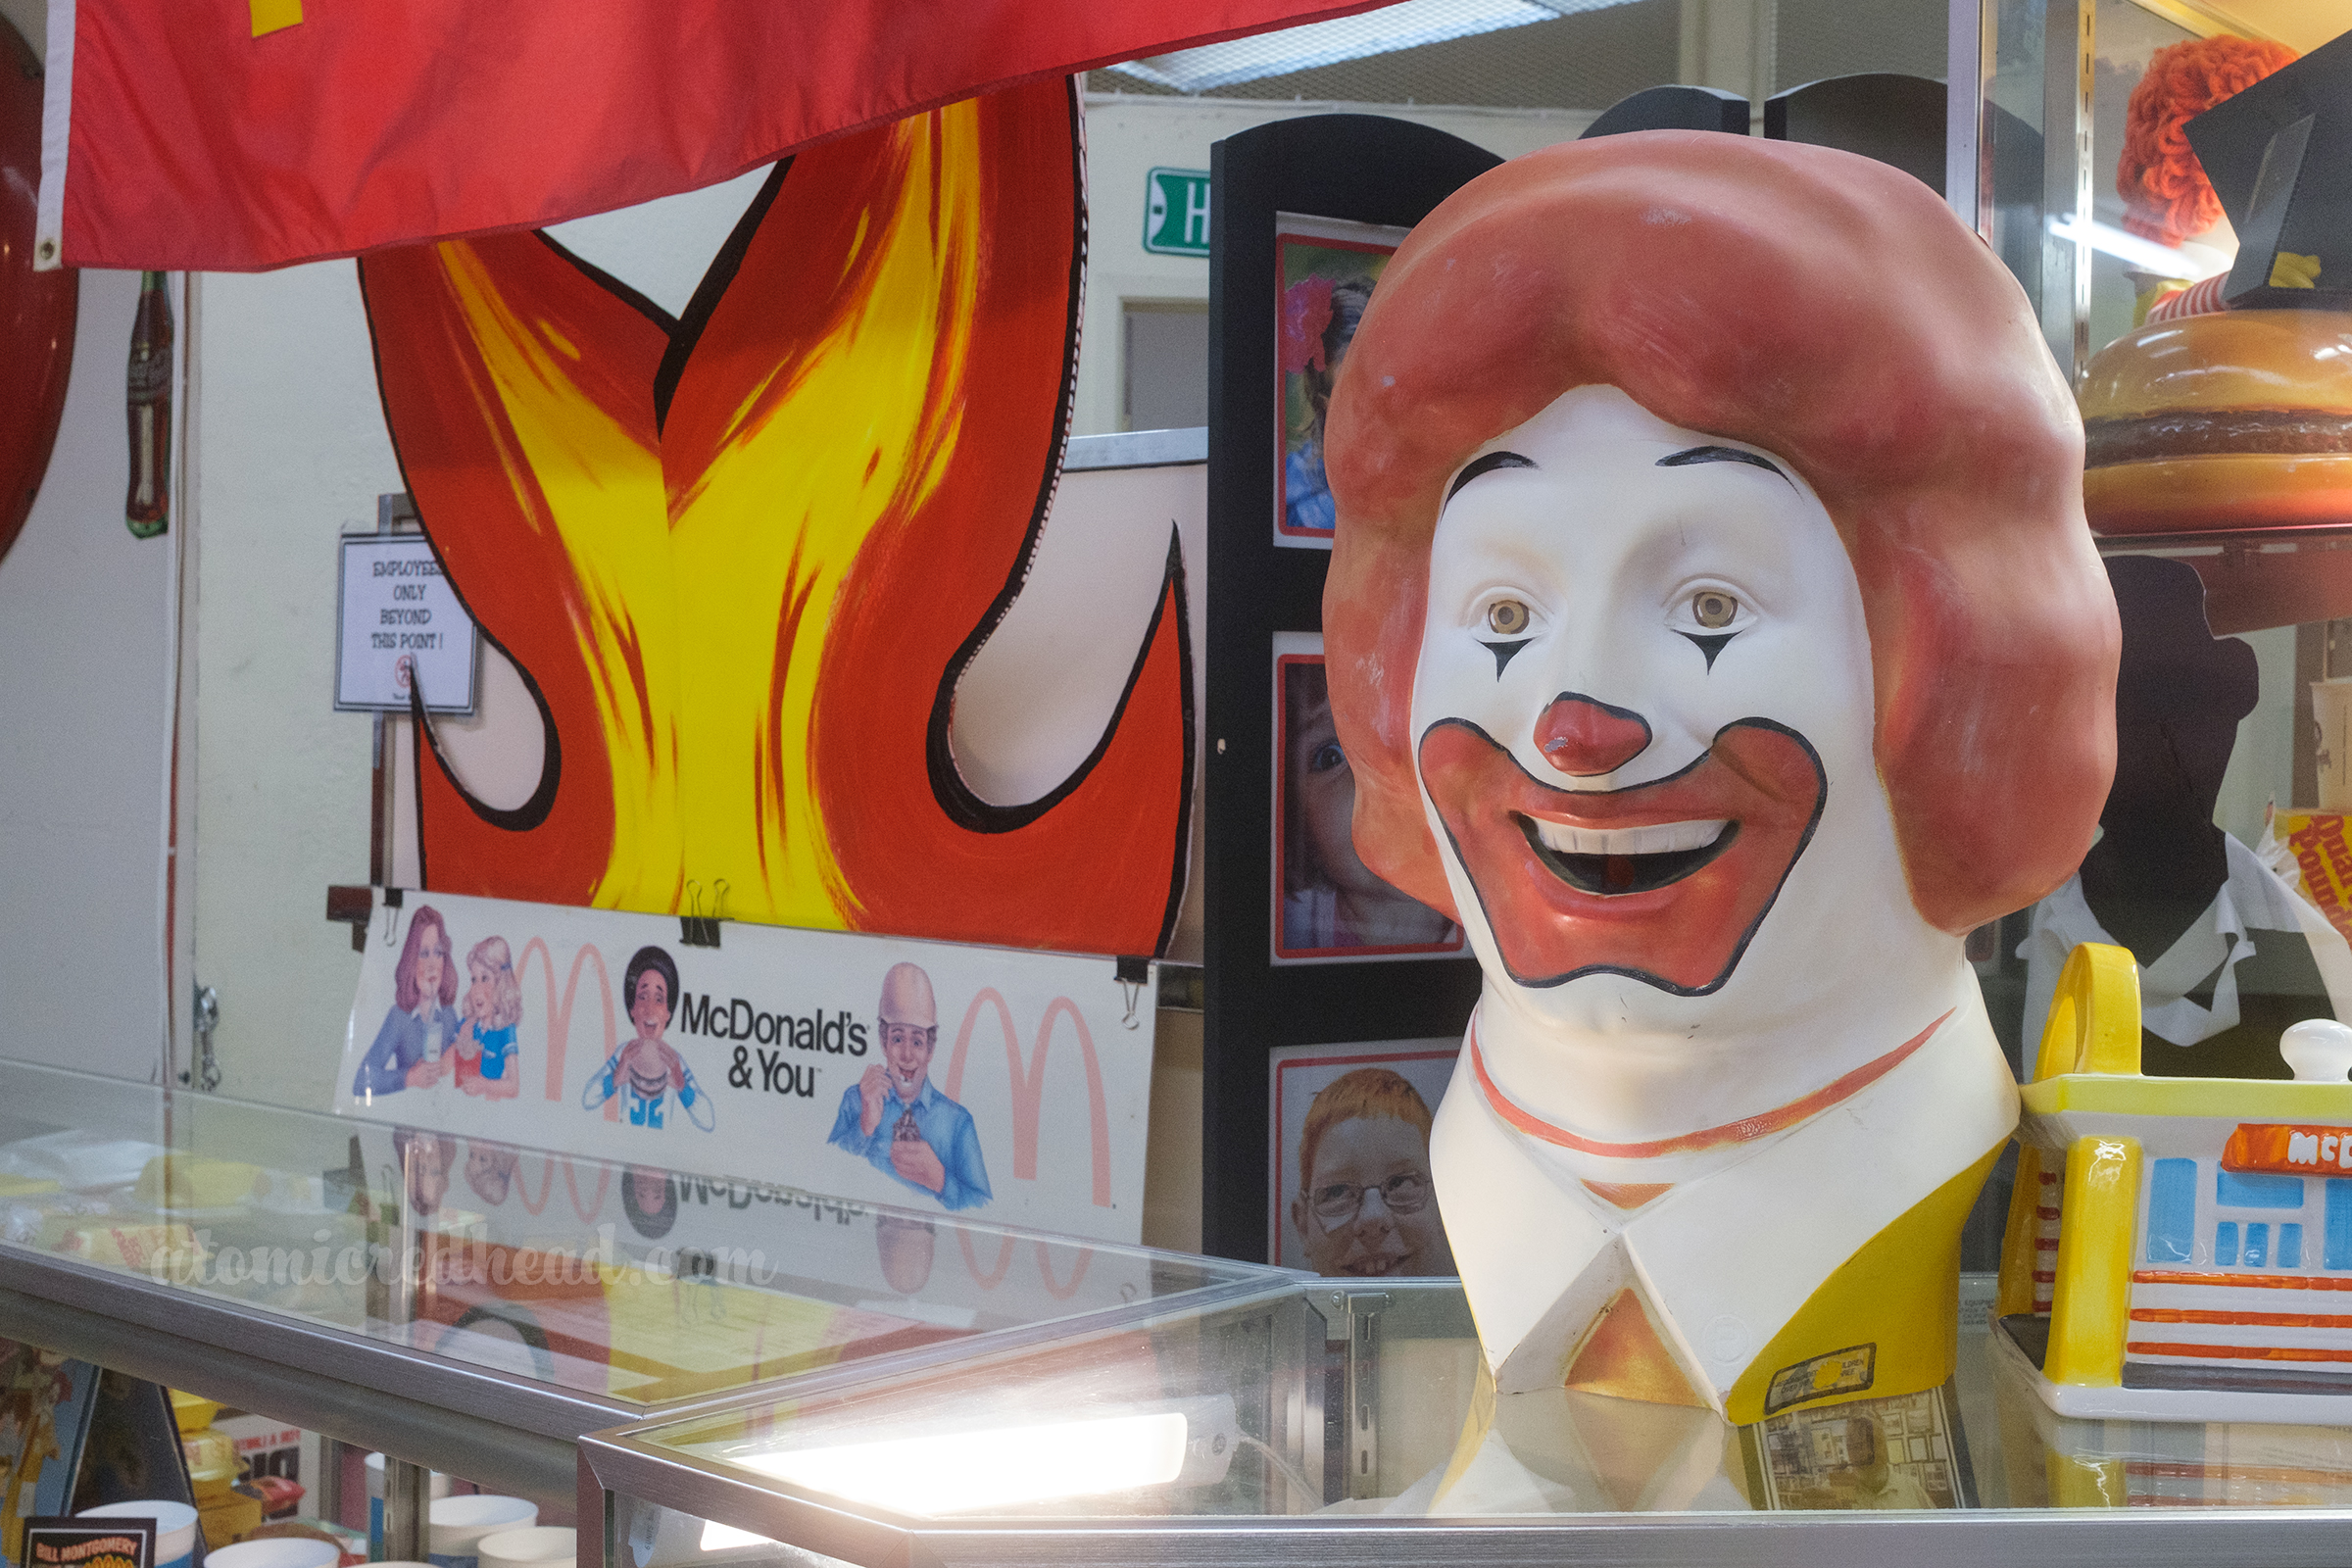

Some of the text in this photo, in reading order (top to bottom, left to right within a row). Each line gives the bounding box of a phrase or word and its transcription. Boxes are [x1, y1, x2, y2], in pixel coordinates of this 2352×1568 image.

[372, 561, 443, 577] EMPLOYEE
[393, 584, 426, 601] ONLY
[379, 609, 432, 625] BEYOND
[370, 632, 397, 649] THIS
[680, 992, 868, 1056] McDonald's
[728, 1045, 814, 1098] & You
